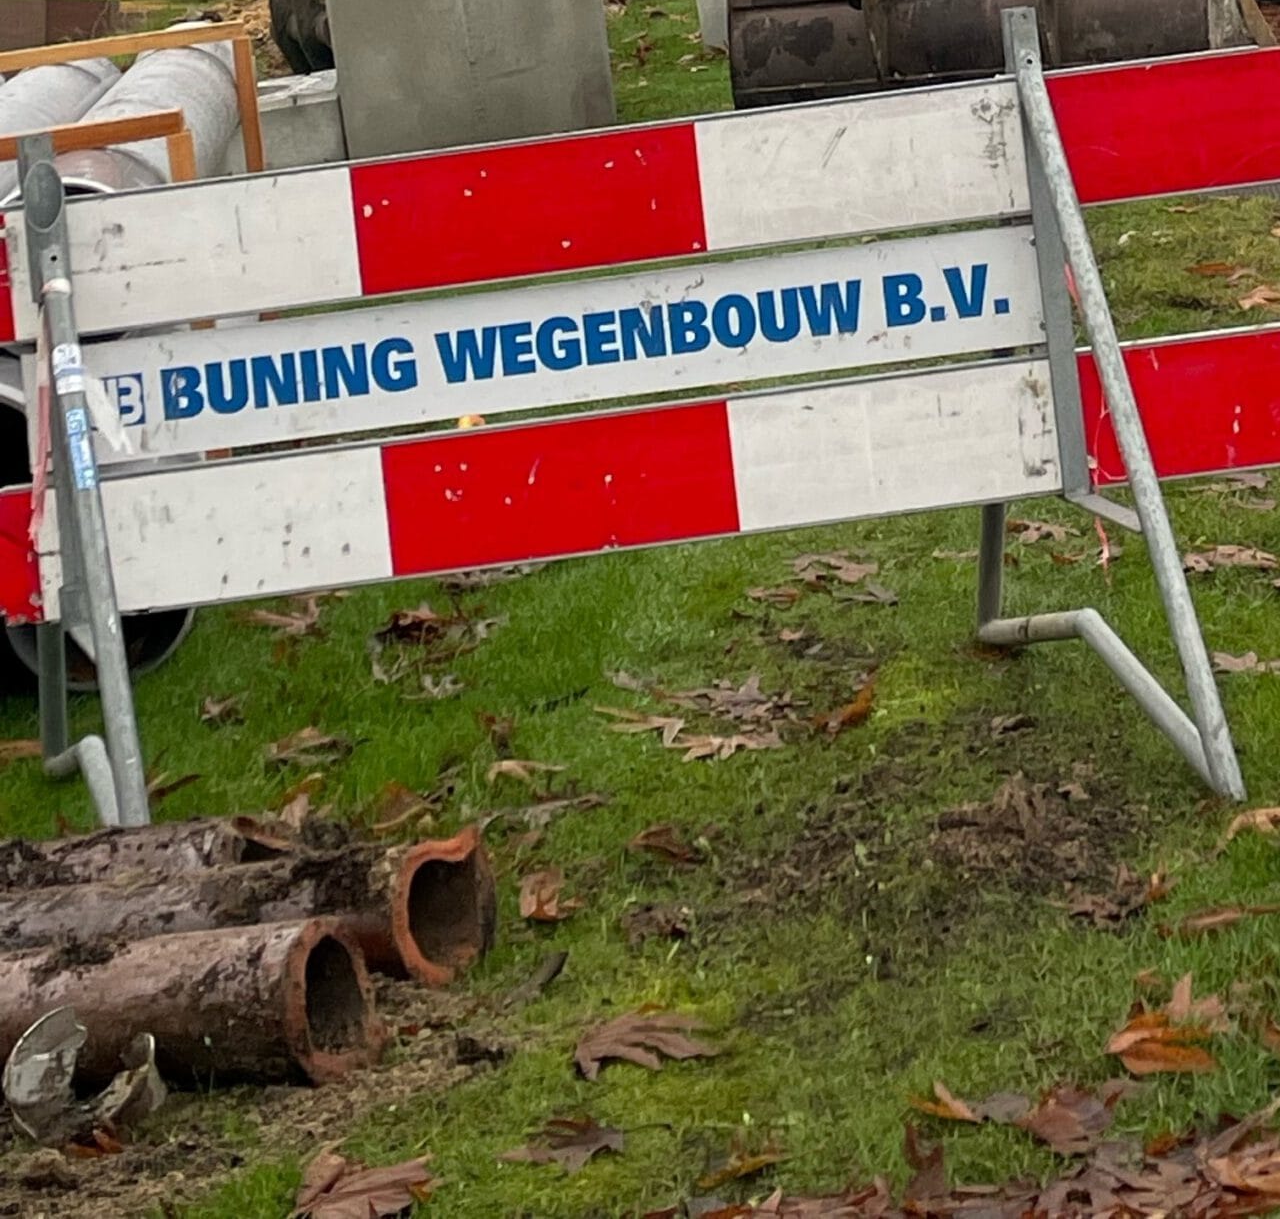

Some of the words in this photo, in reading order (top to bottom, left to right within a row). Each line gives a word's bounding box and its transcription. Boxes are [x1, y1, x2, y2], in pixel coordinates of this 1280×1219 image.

[160, 337, 418, 422] BUNING
[434, 279, 861, 384] WEGENBOUW
[883, 263, 1011, 328] B.V.
